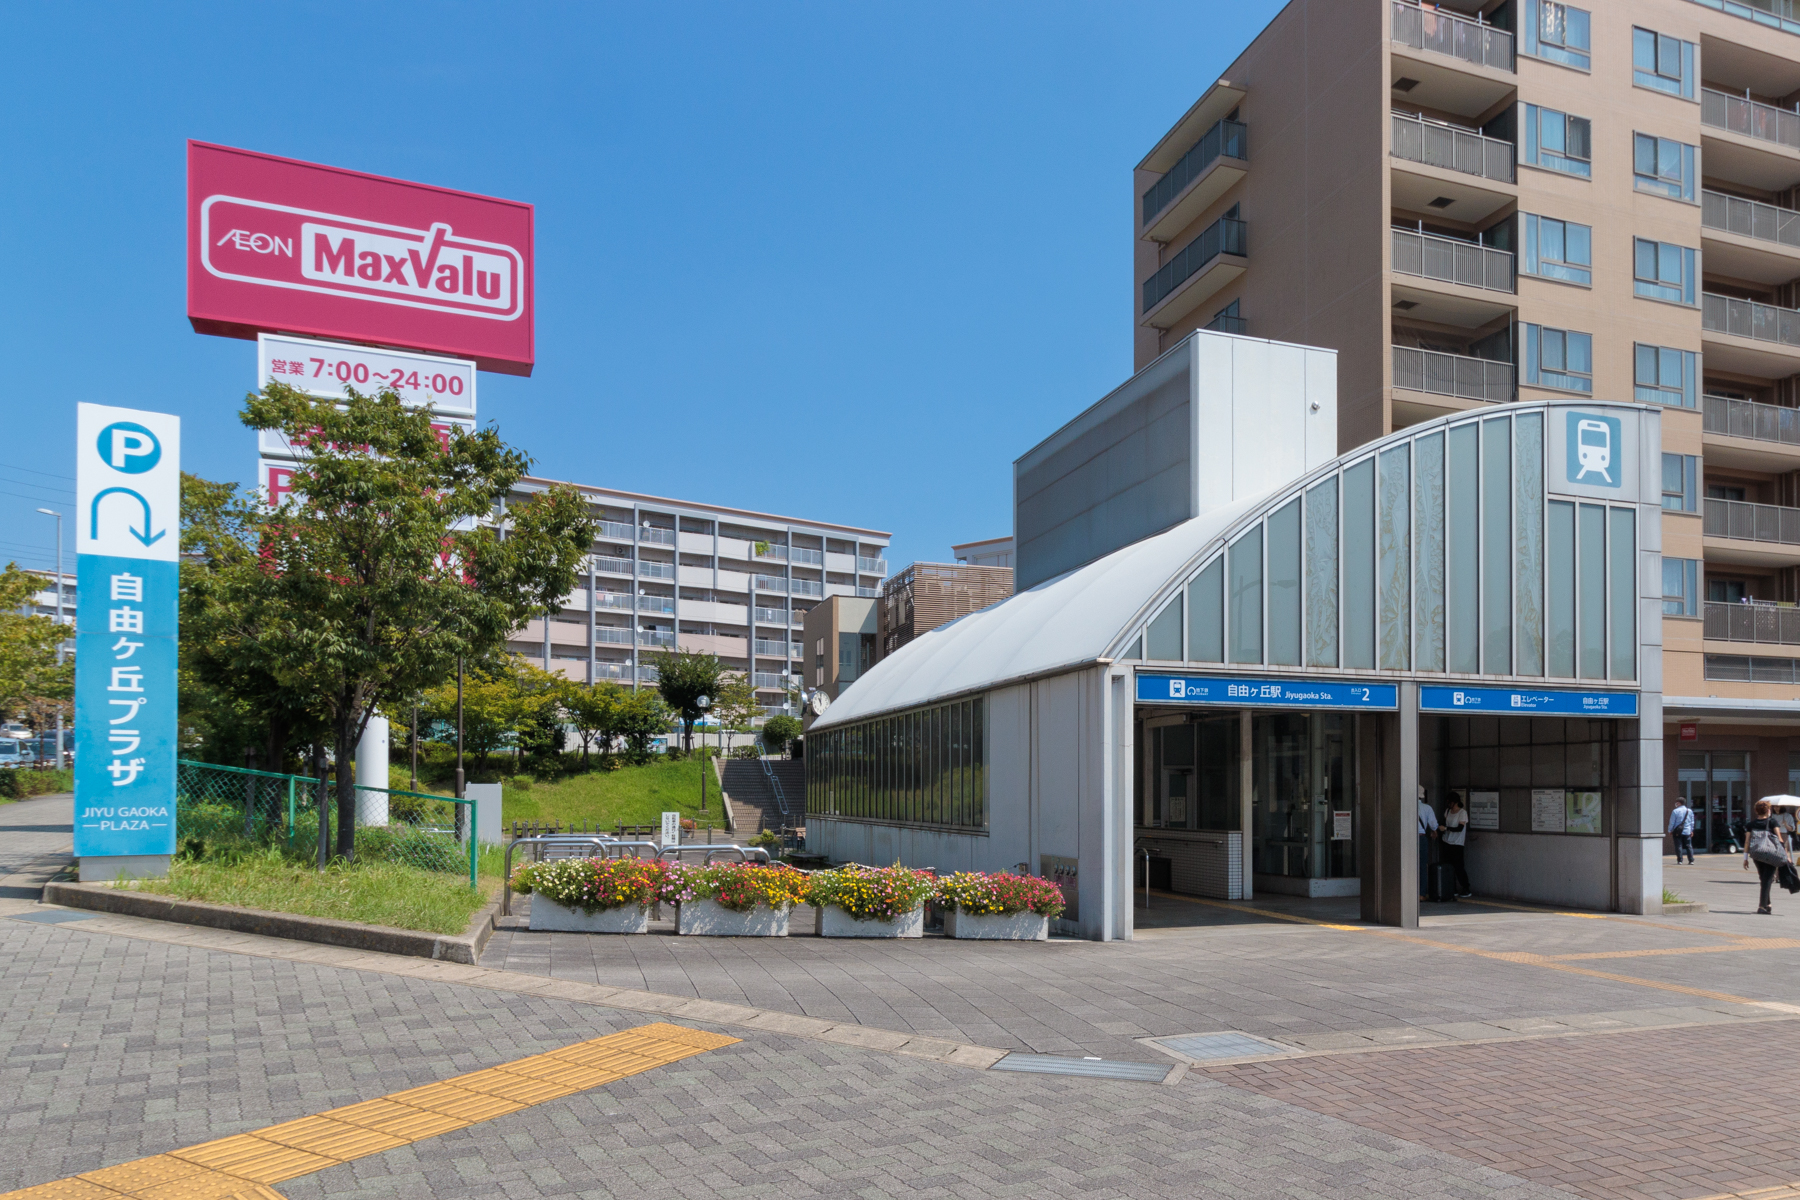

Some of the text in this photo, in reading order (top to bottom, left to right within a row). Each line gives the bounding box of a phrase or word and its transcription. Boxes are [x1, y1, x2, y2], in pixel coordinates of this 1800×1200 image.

[314, 228, 501, 301] MaxValu
[271, 359, 304, 376] 営業
[112, 430, 154, 466] P
[1285, 691, 1333, 700] Jiyugaoka Sta.
[1362, 688, 1370, 701] 2
[1521, 695, 1555, 704] エレベーター
[82, 806, 168, 818] JIYU GAOKA
[100, 820, 150, 831] PLAZA
